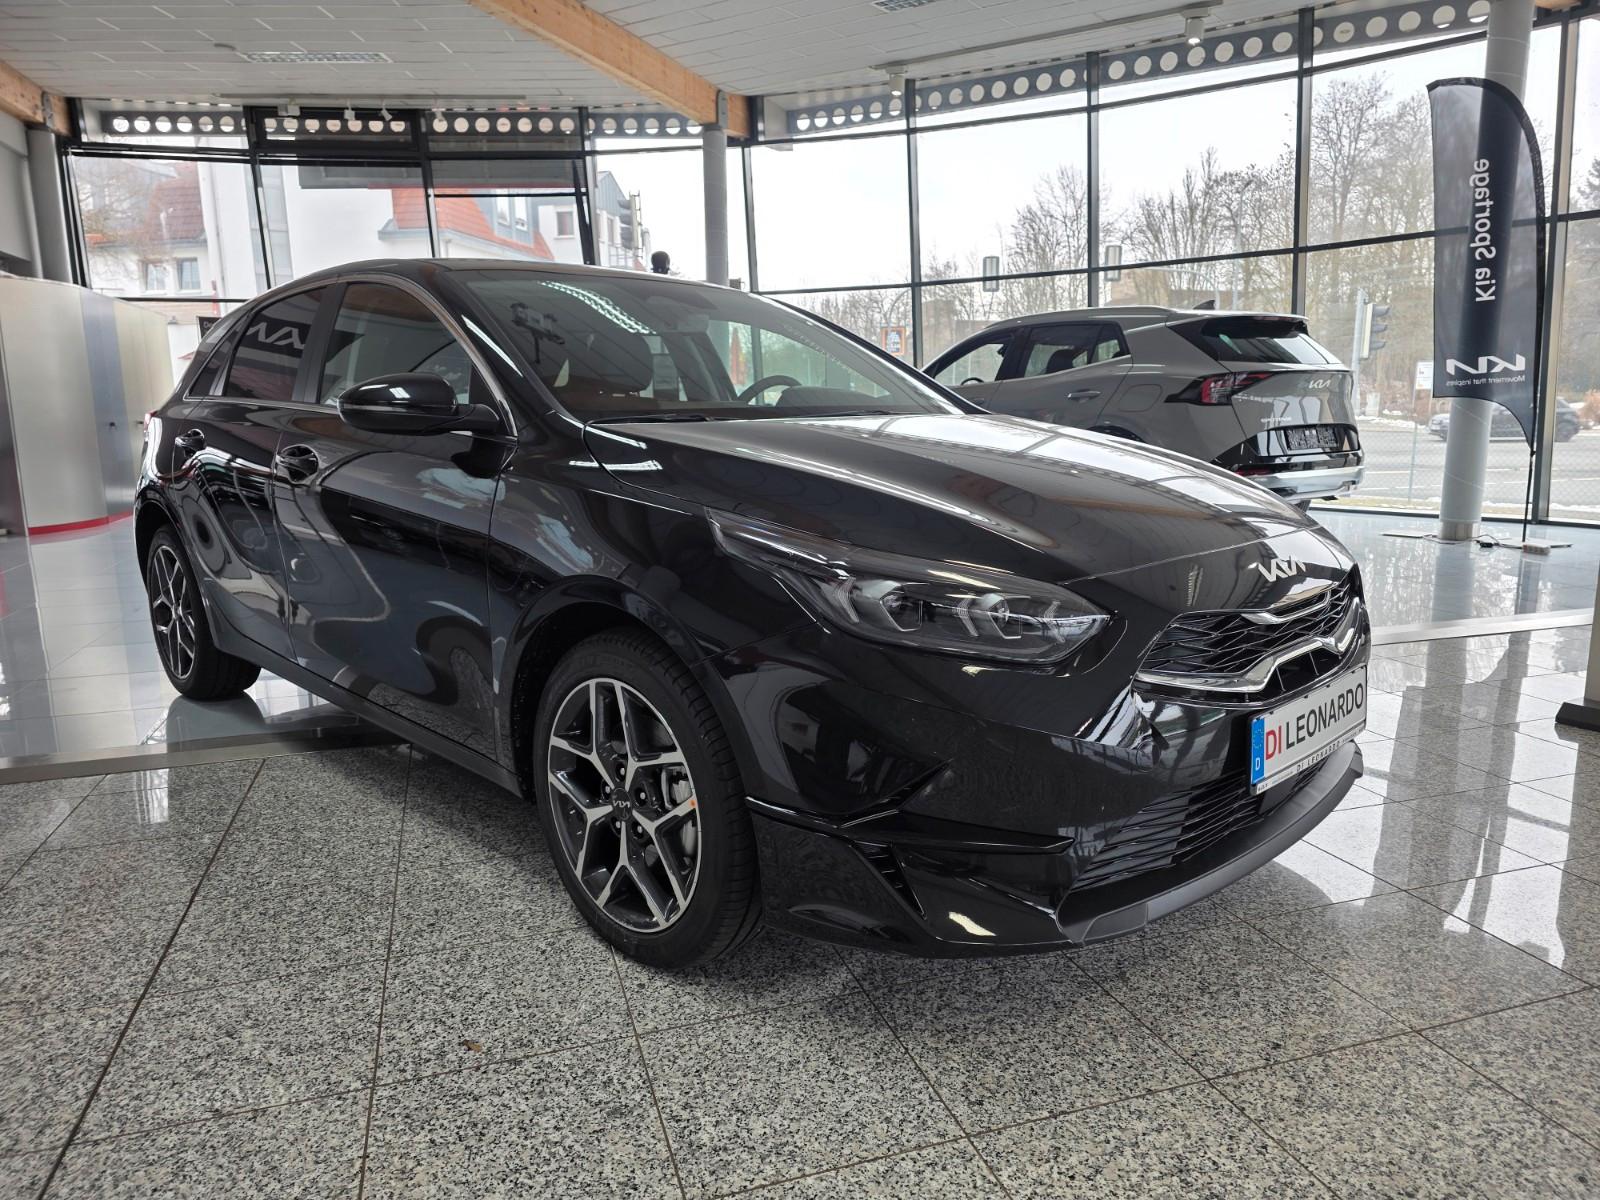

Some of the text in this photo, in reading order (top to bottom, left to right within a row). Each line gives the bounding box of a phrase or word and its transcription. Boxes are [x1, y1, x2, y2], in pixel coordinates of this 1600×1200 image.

[1308, 379, 1331, 389] KIA
[1258, 553, 1306, 582] KIA
[1265, 682, 1364, 761] DI LEONARDO
[1255, 757, 1261, 771] D
[1307, 739, 1340, 766] LEONARDO
